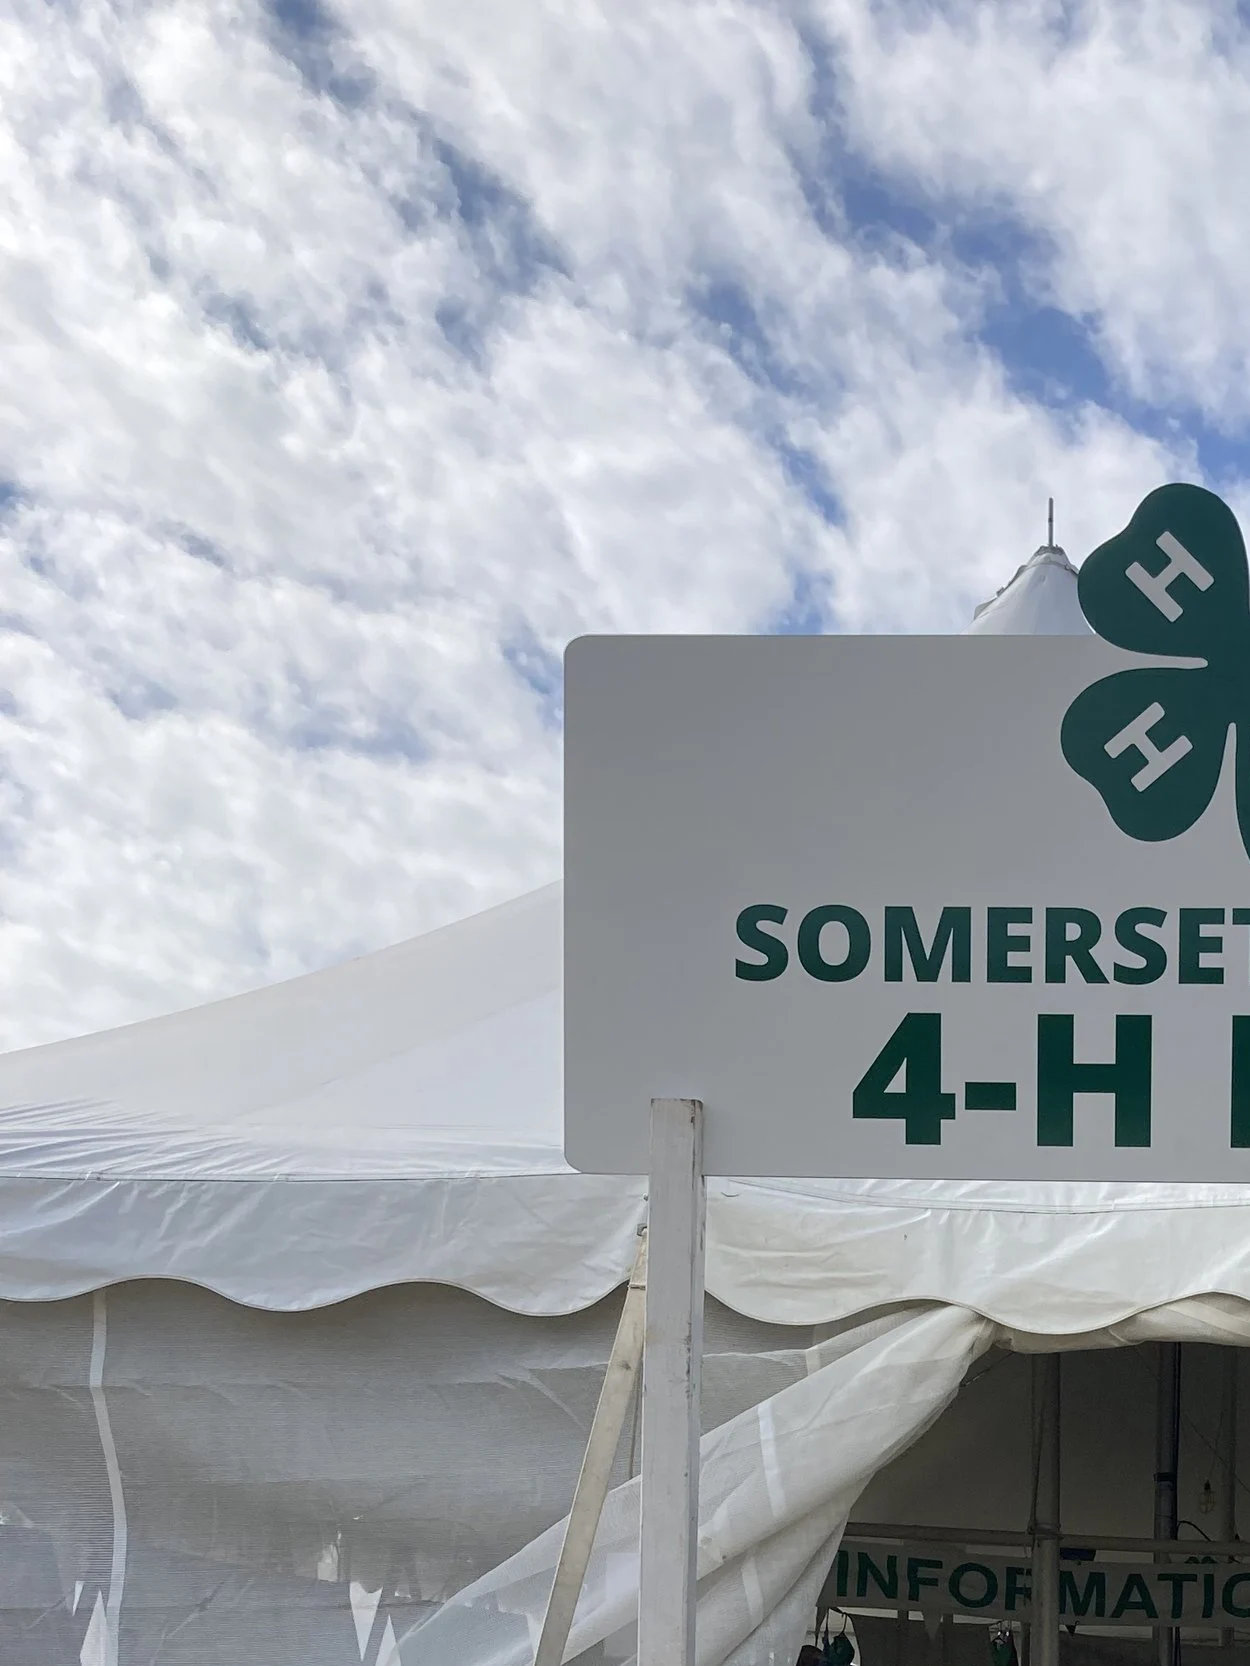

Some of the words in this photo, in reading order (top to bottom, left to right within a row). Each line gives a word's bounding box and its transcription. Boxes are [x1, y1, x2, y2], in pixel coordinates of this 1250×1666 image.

[1125, 530, 1215, 623] H
[1103, 701, 1194, 792] H
[851, 1011, 1152, 1148] 4-H
